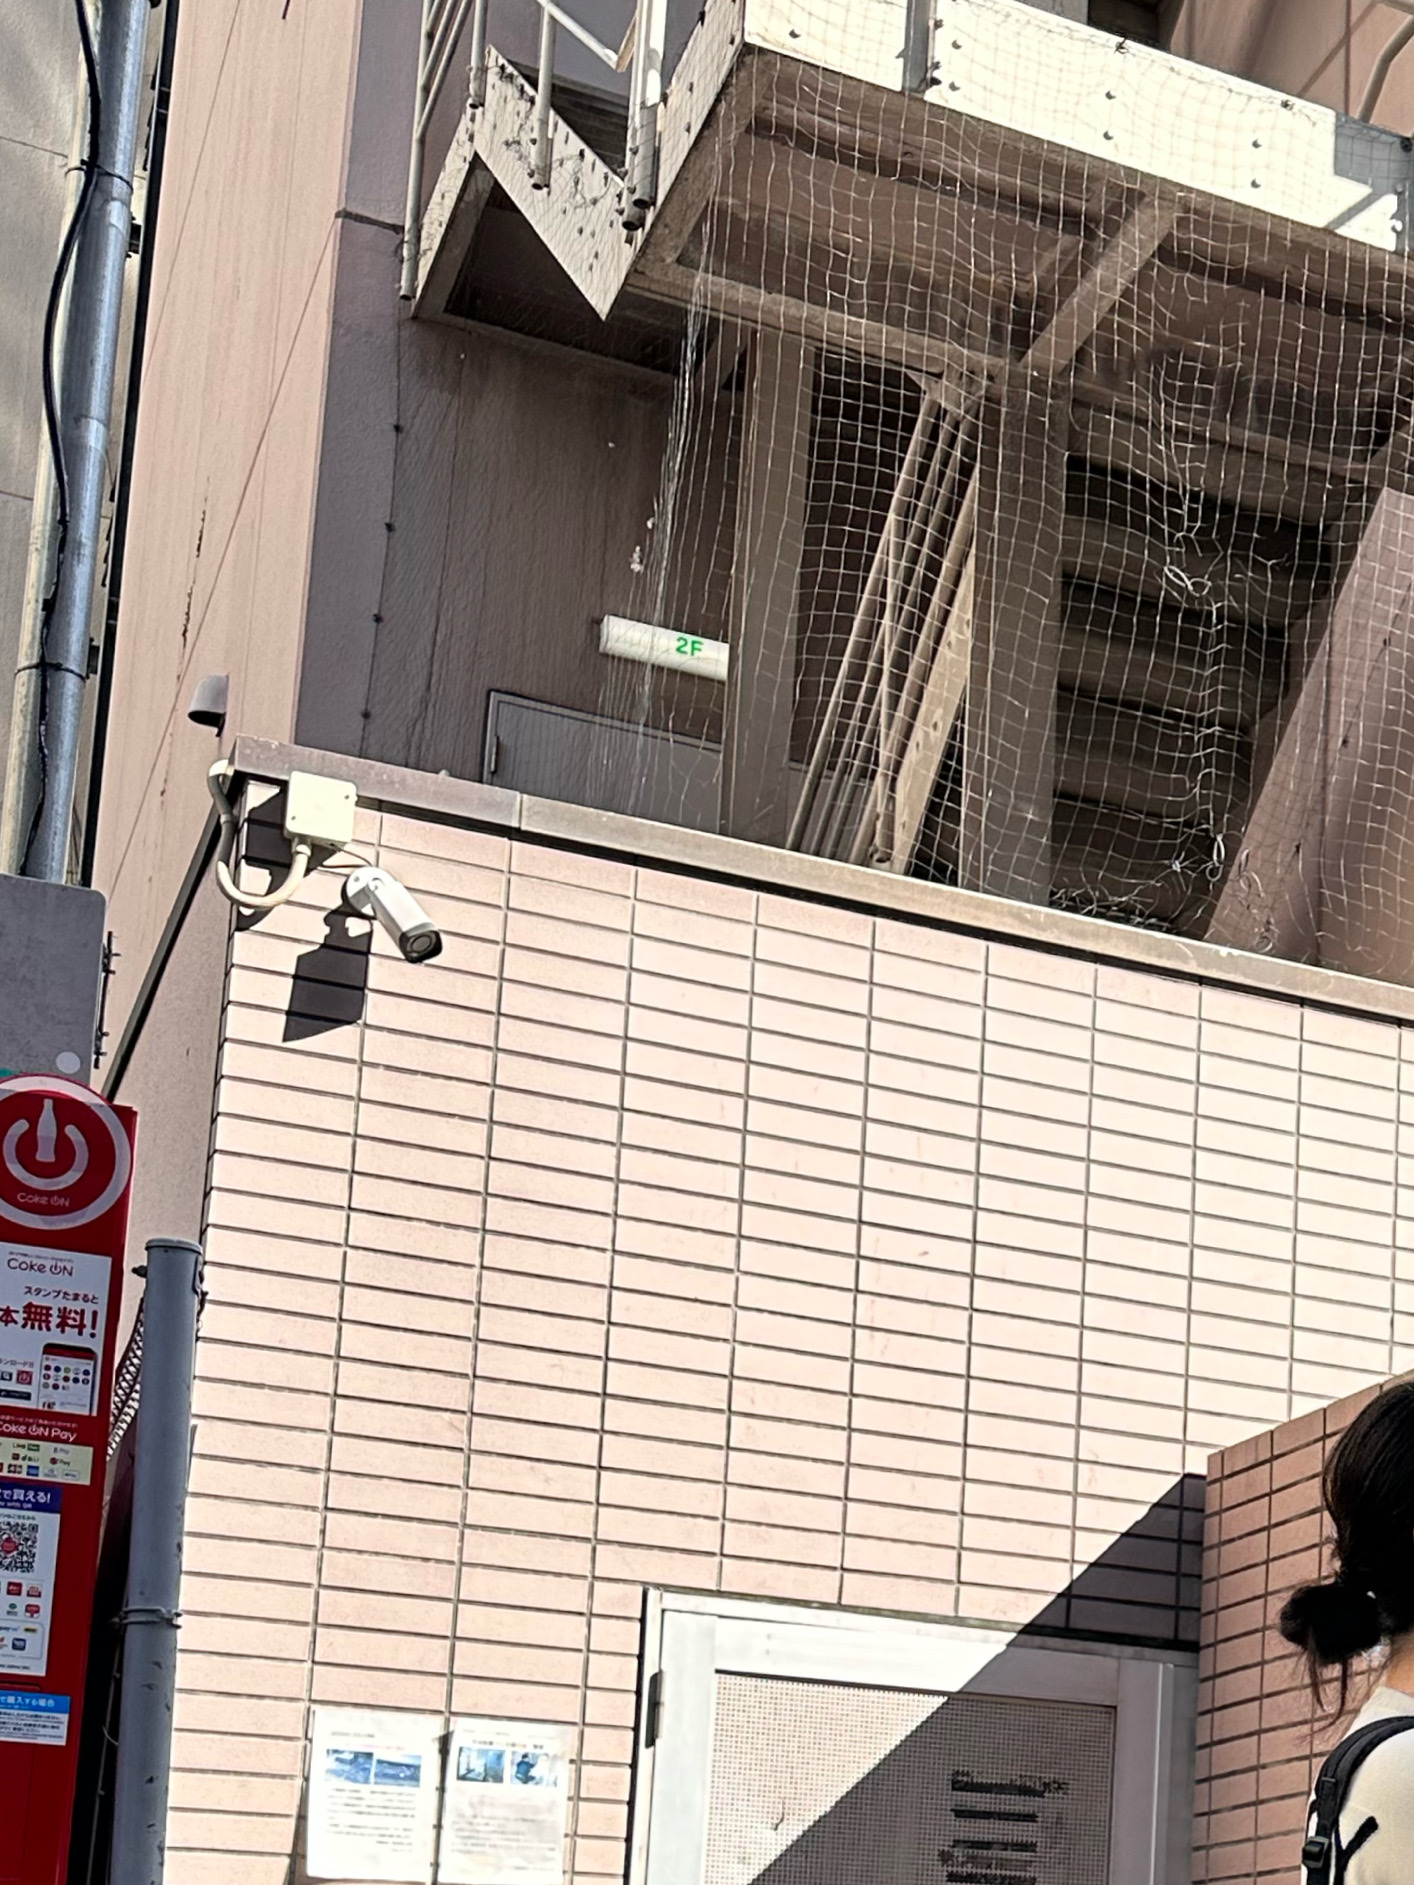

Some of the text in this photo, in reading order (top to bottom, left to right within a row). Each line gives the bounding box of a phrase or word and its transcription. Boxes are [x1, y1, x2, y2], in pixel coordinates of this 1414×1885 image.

[675, 636, 704, 656] 2F
[17, 1192, 48, 1205] Coke
[7, 1257, 47, 1274] Coke
[49, 1260, 74, 1277] ON
[24, 1286, 99, 1304] スタンプたまると
[28, 1423, 49, 1437] ON
[51, 1427, 77, 1443] Pay
[0, 1488, 51, 1504] で買える!
